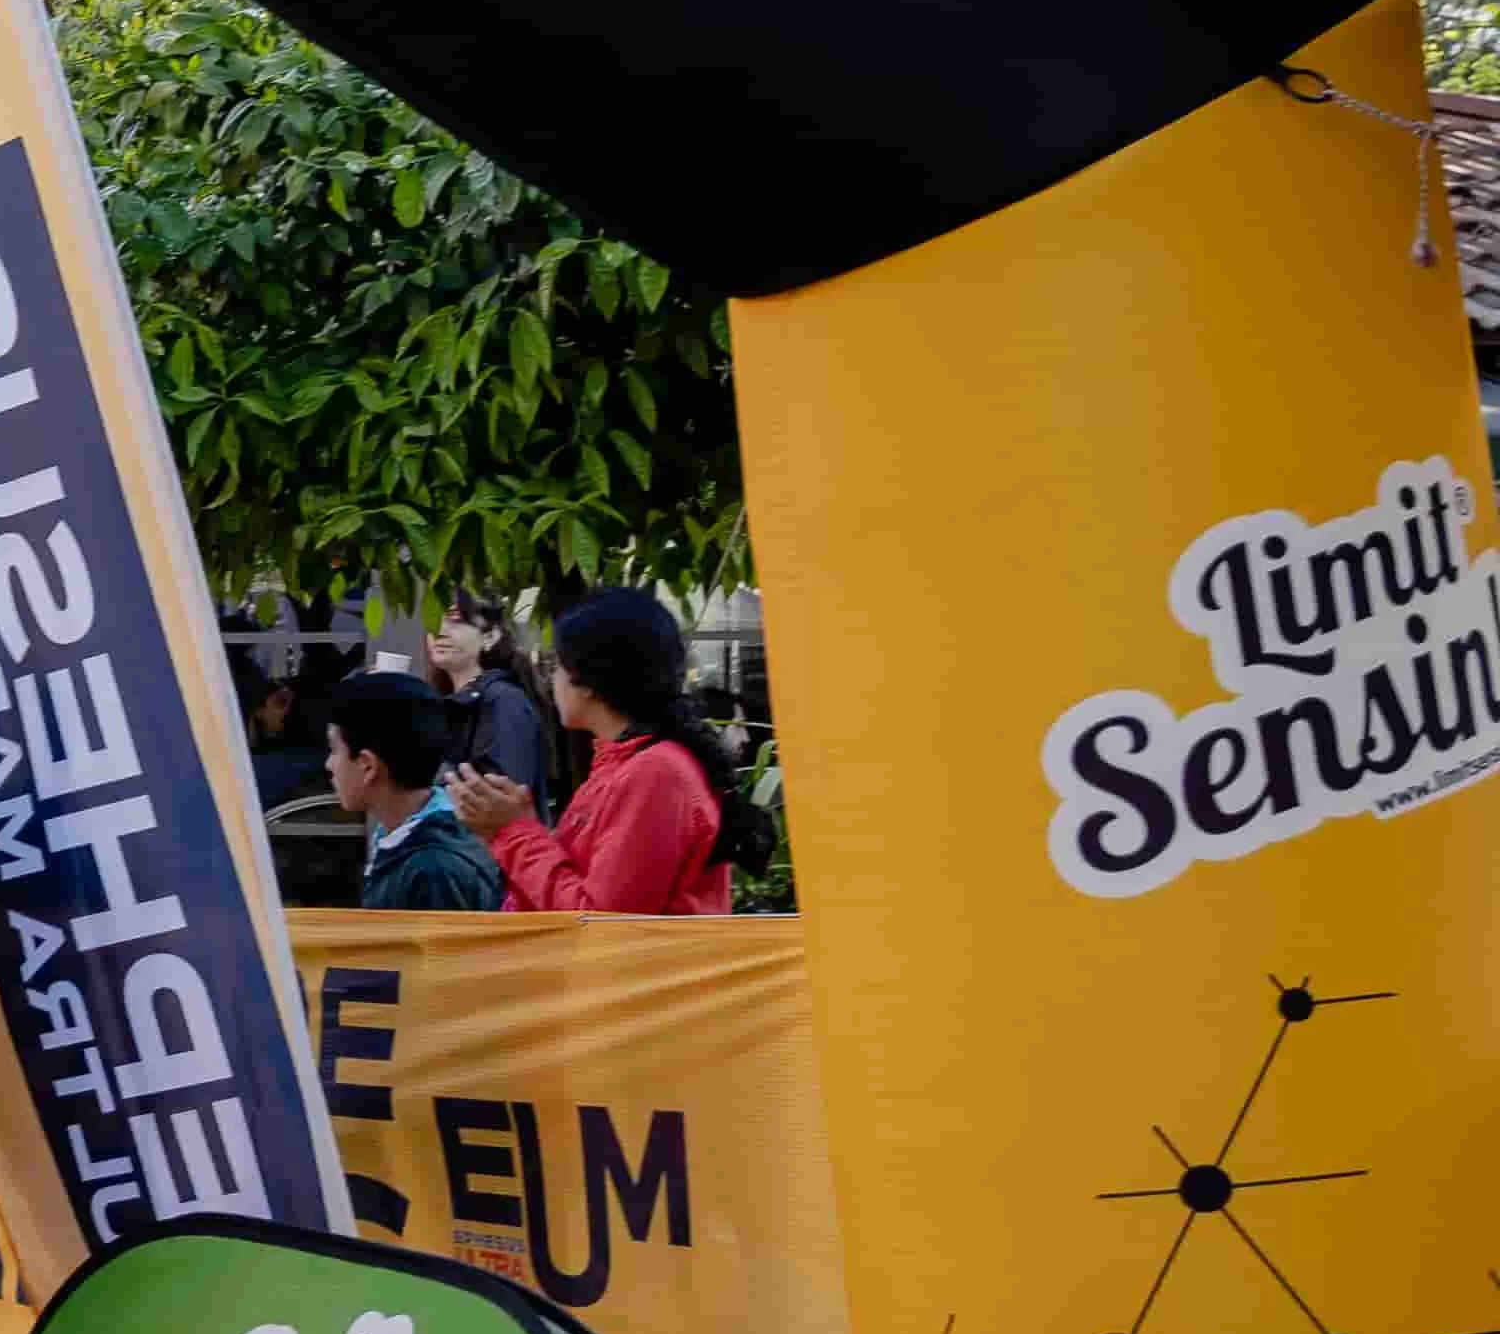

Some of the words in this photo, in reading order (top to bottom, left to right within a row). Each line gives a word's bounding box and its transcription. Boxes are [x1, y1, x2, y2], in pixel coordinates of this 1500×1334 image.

[1197, 481, 1459, 677] Limit
[1070, 572, 1500, 873] Sensin
[433, 1096, 693, 1308] EUM
